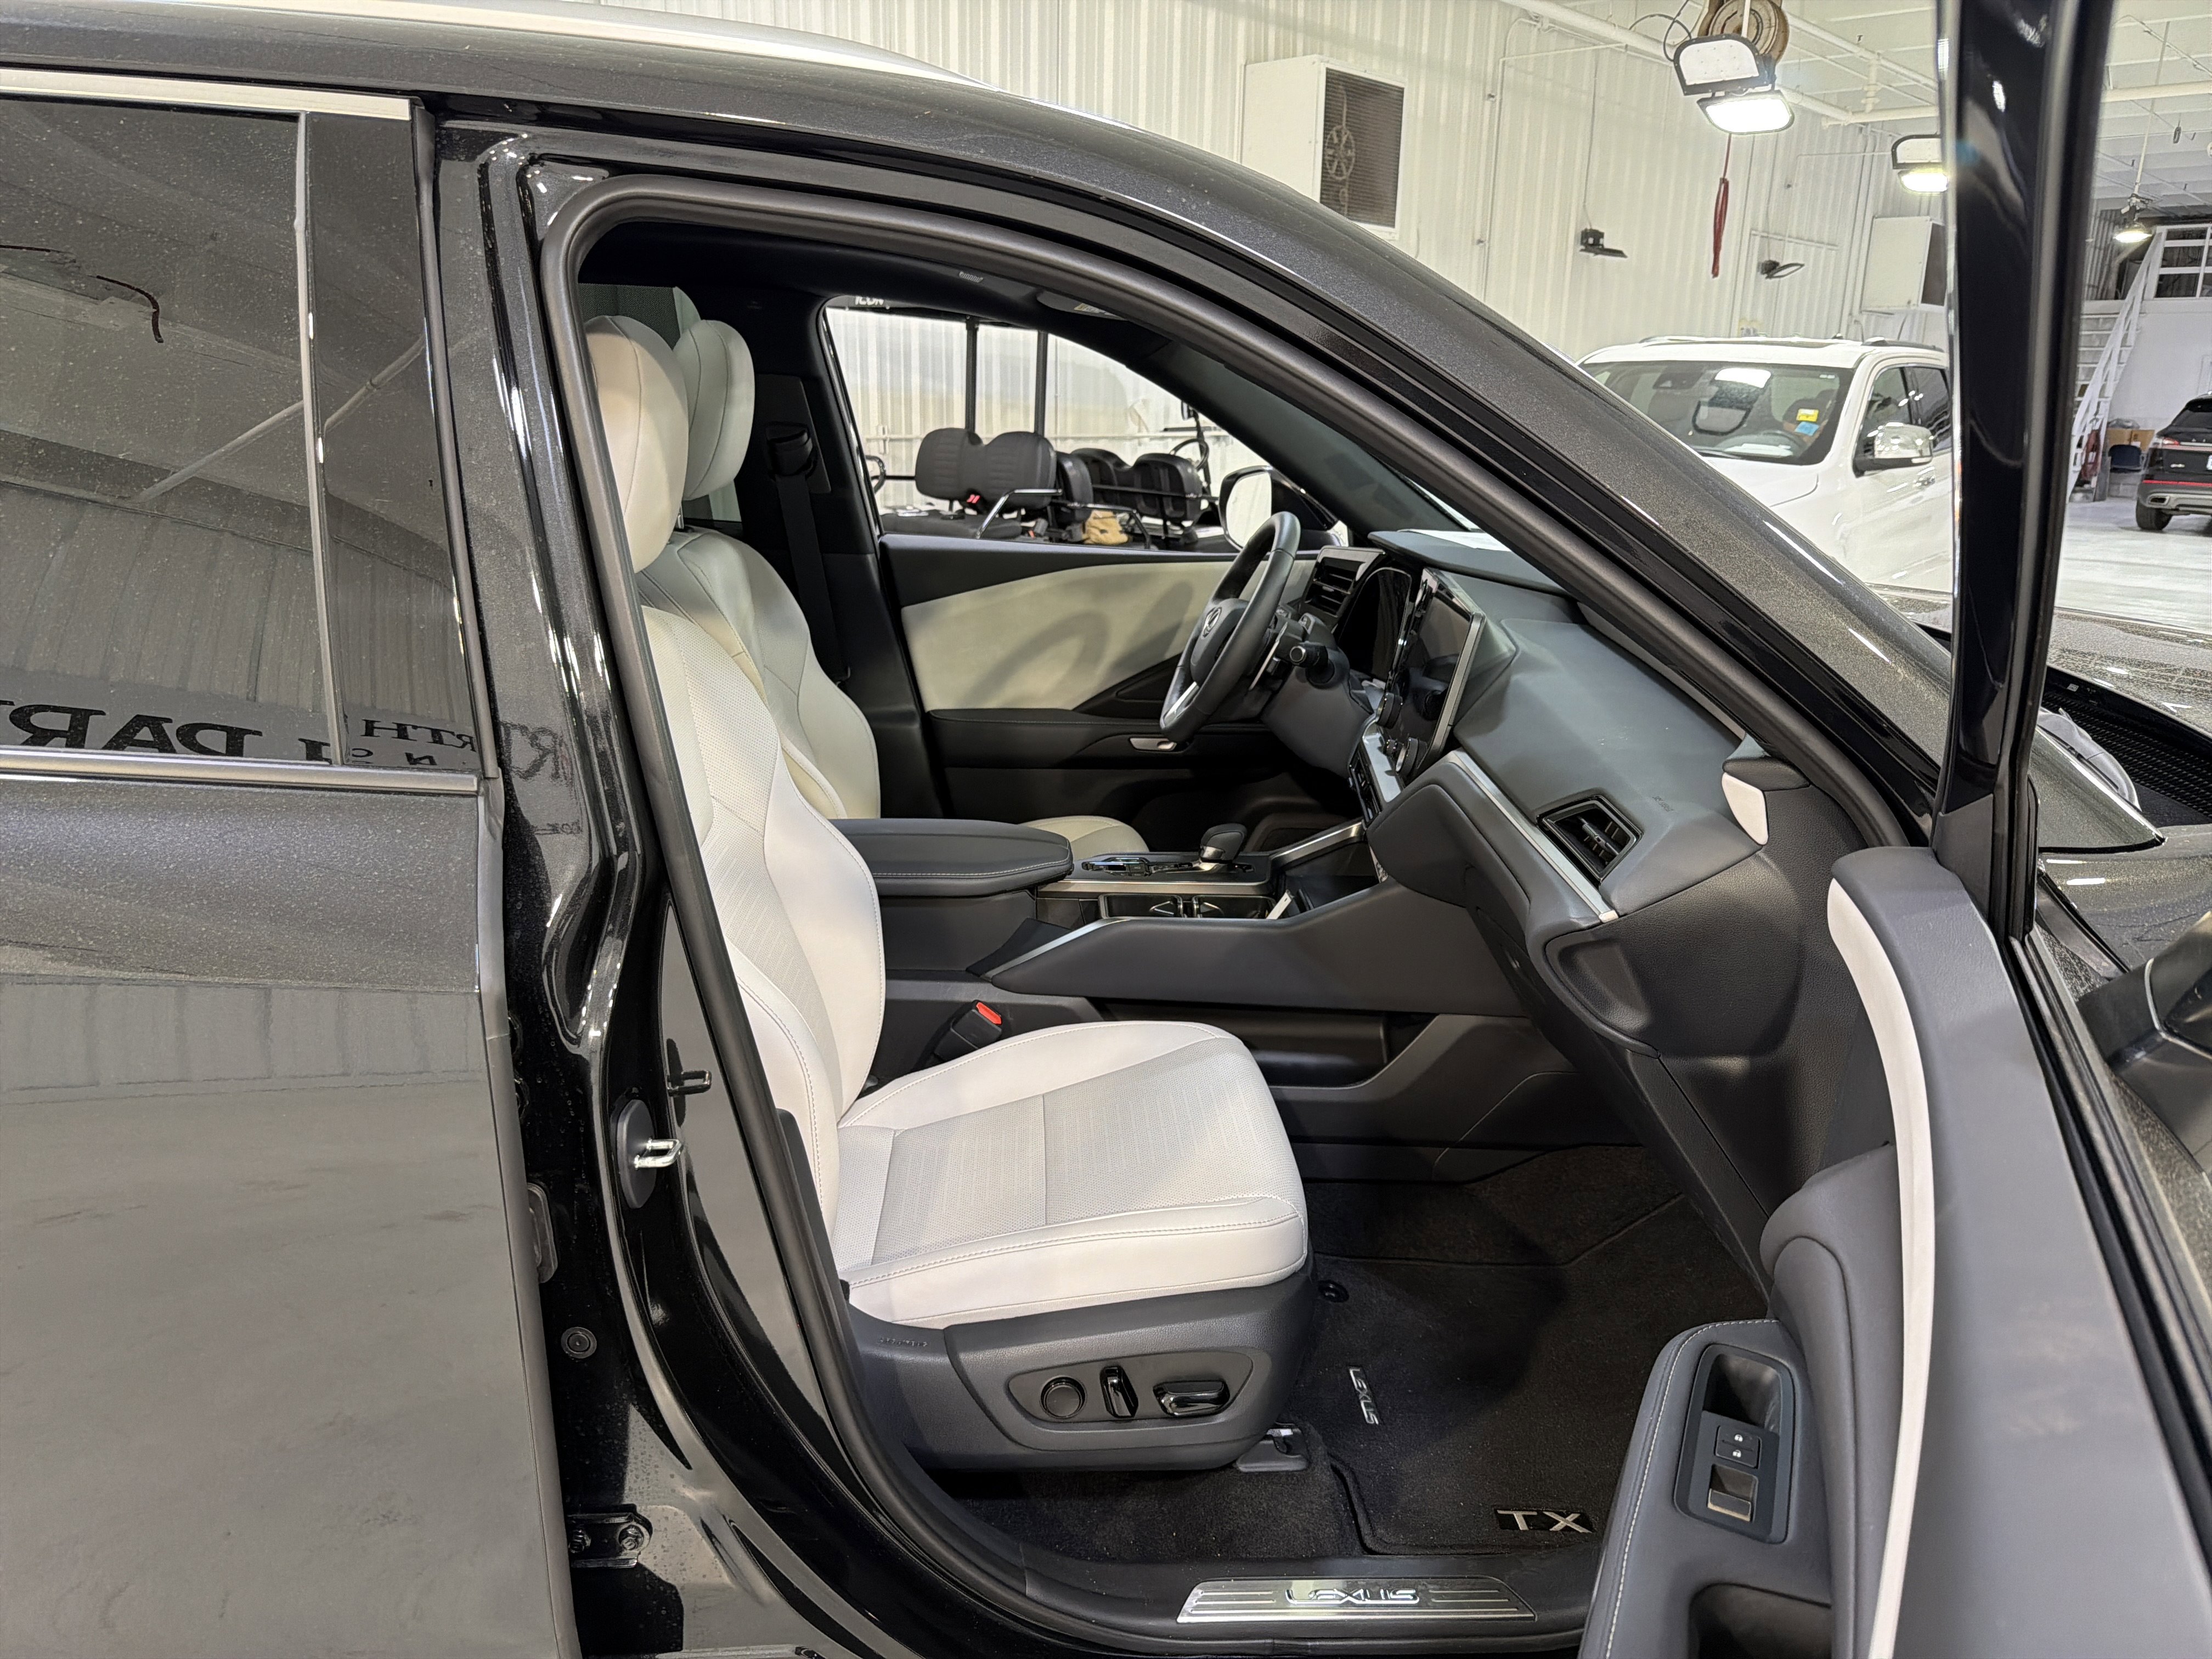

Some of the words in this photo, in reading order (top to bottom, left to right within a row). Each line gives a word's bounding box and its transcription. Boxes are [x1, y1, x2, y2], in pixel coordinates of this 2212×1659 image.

[1349, 1368, 1379, 1425] LEXUS
[1497, 1509, 1593, 1533] TX
[1285, 1588, 1420, 1605] LEXUS
